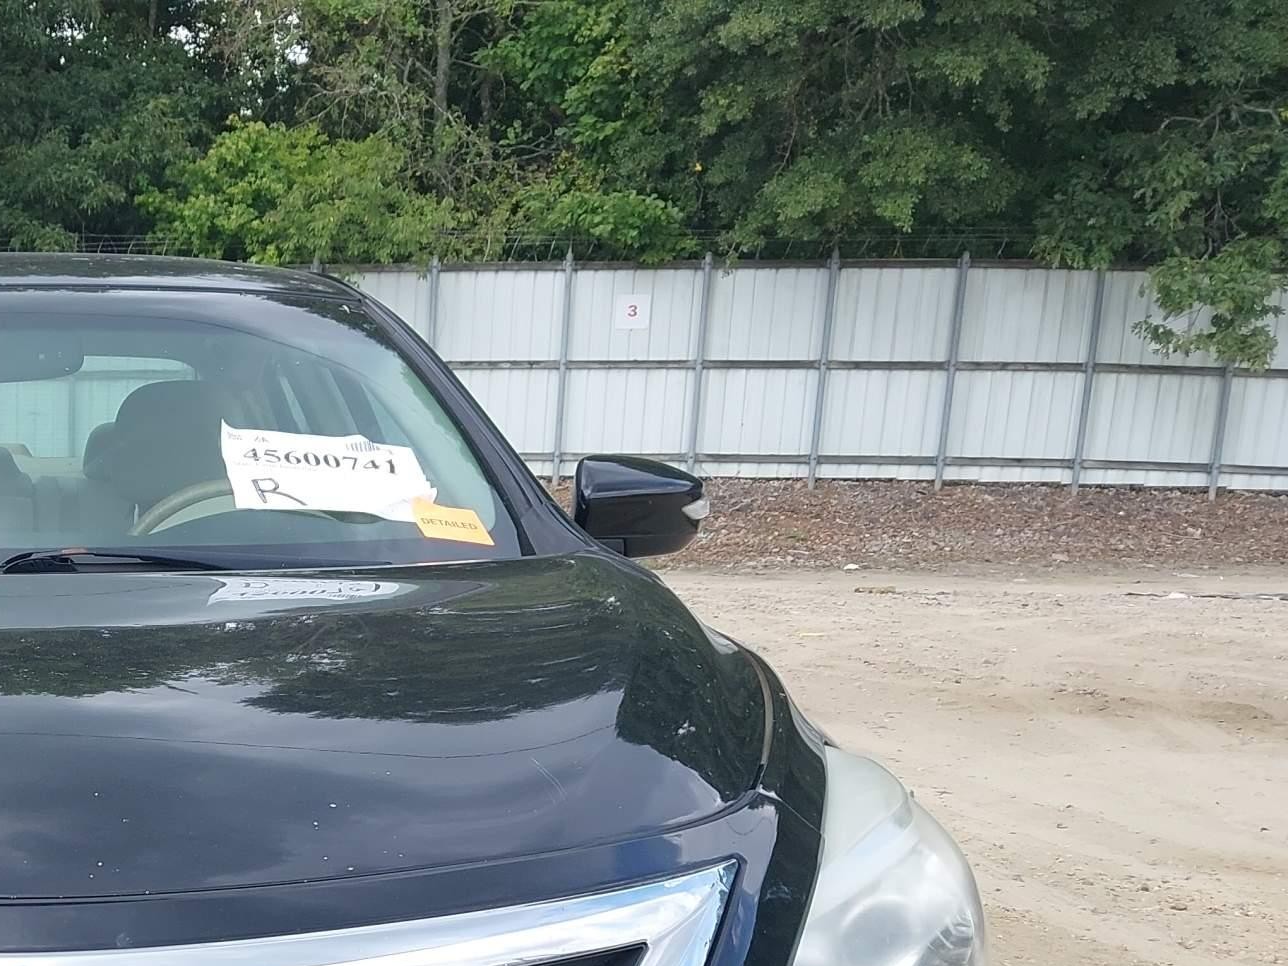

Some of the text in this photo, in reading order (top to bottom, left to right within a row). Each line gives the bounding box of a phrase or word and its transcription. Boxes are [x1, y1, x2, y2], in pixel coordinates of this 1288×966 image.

[627, 304, 638, 318] 3
[243, 448, 397, 475] 45600741
[420, 517, 479, 530] DETAILED
